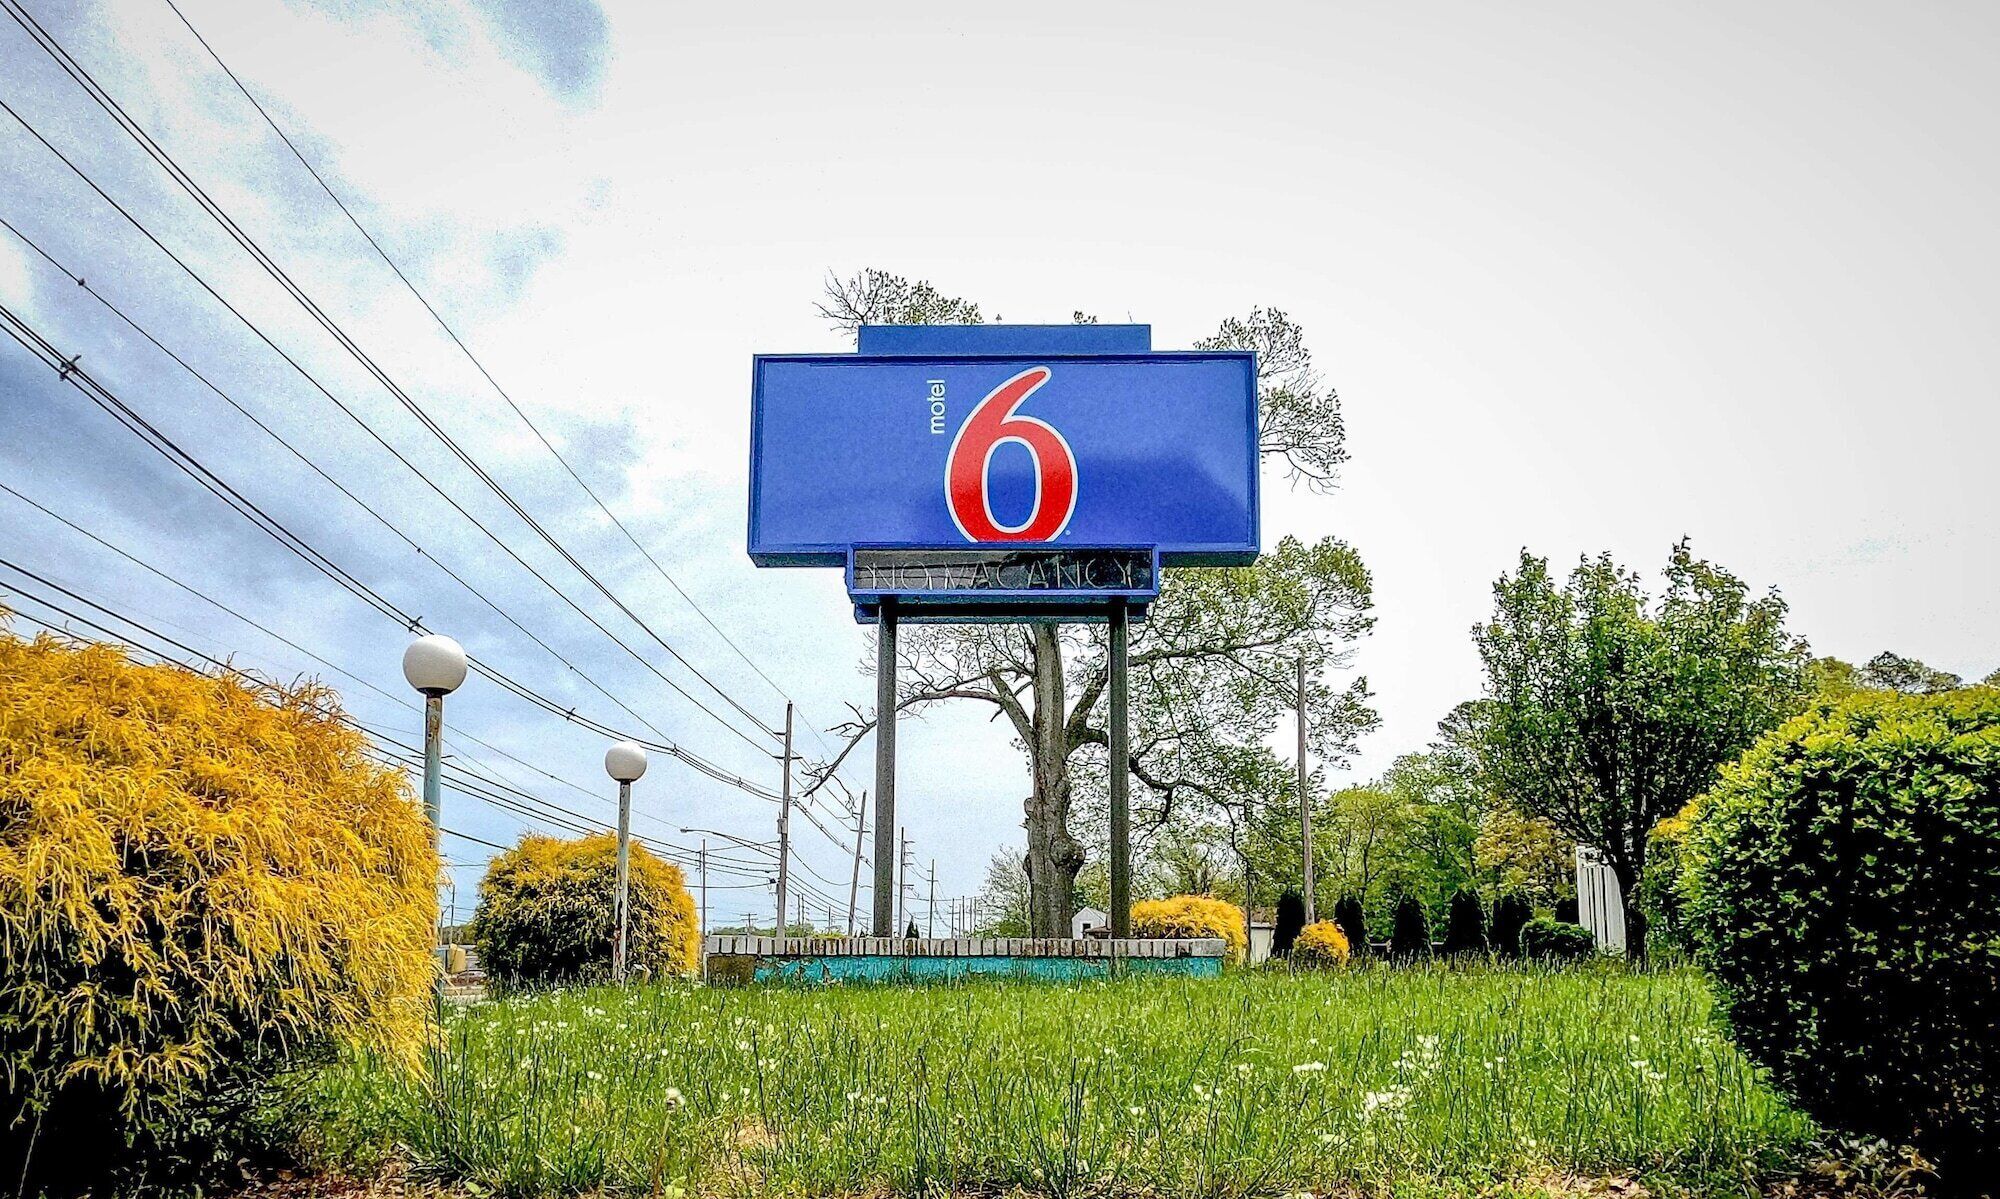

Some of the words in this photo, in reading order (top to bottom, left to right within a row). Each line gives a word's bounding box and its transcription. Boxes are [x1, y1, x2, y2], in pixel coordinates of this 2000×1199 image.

[926, 379, 946, 435] motel
[944, 365, 1079, 543] 6
[868, 560, 931, 590] NO
[944, 558, 1134, 590] VACANCY
